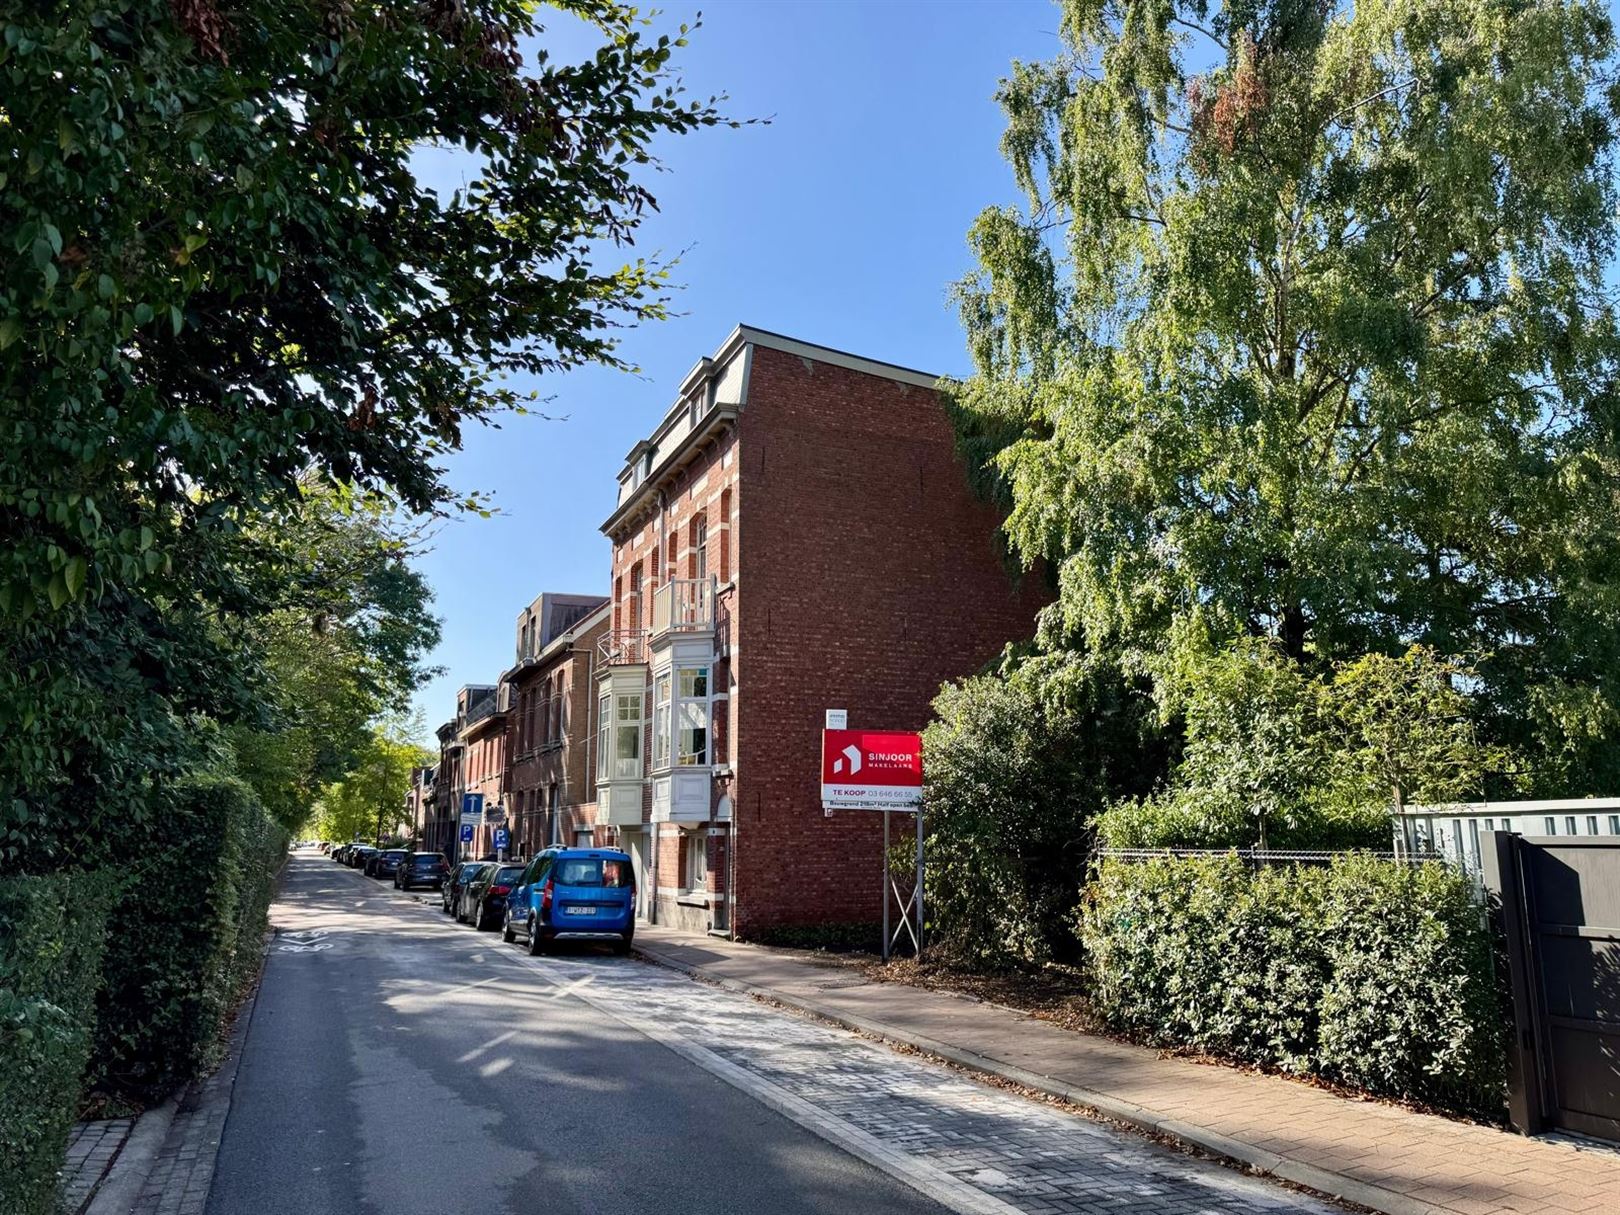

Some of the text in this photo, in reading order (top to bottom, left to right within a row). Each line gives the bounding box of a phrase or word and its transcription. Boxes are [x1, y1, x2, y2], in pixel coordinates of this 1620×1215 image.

[868, 753, 912, 761] SINJOOR
[844, 789, 866, 797] KOOP
[464, 826, 471, 834] P
[496, 830, 505, 841] P
